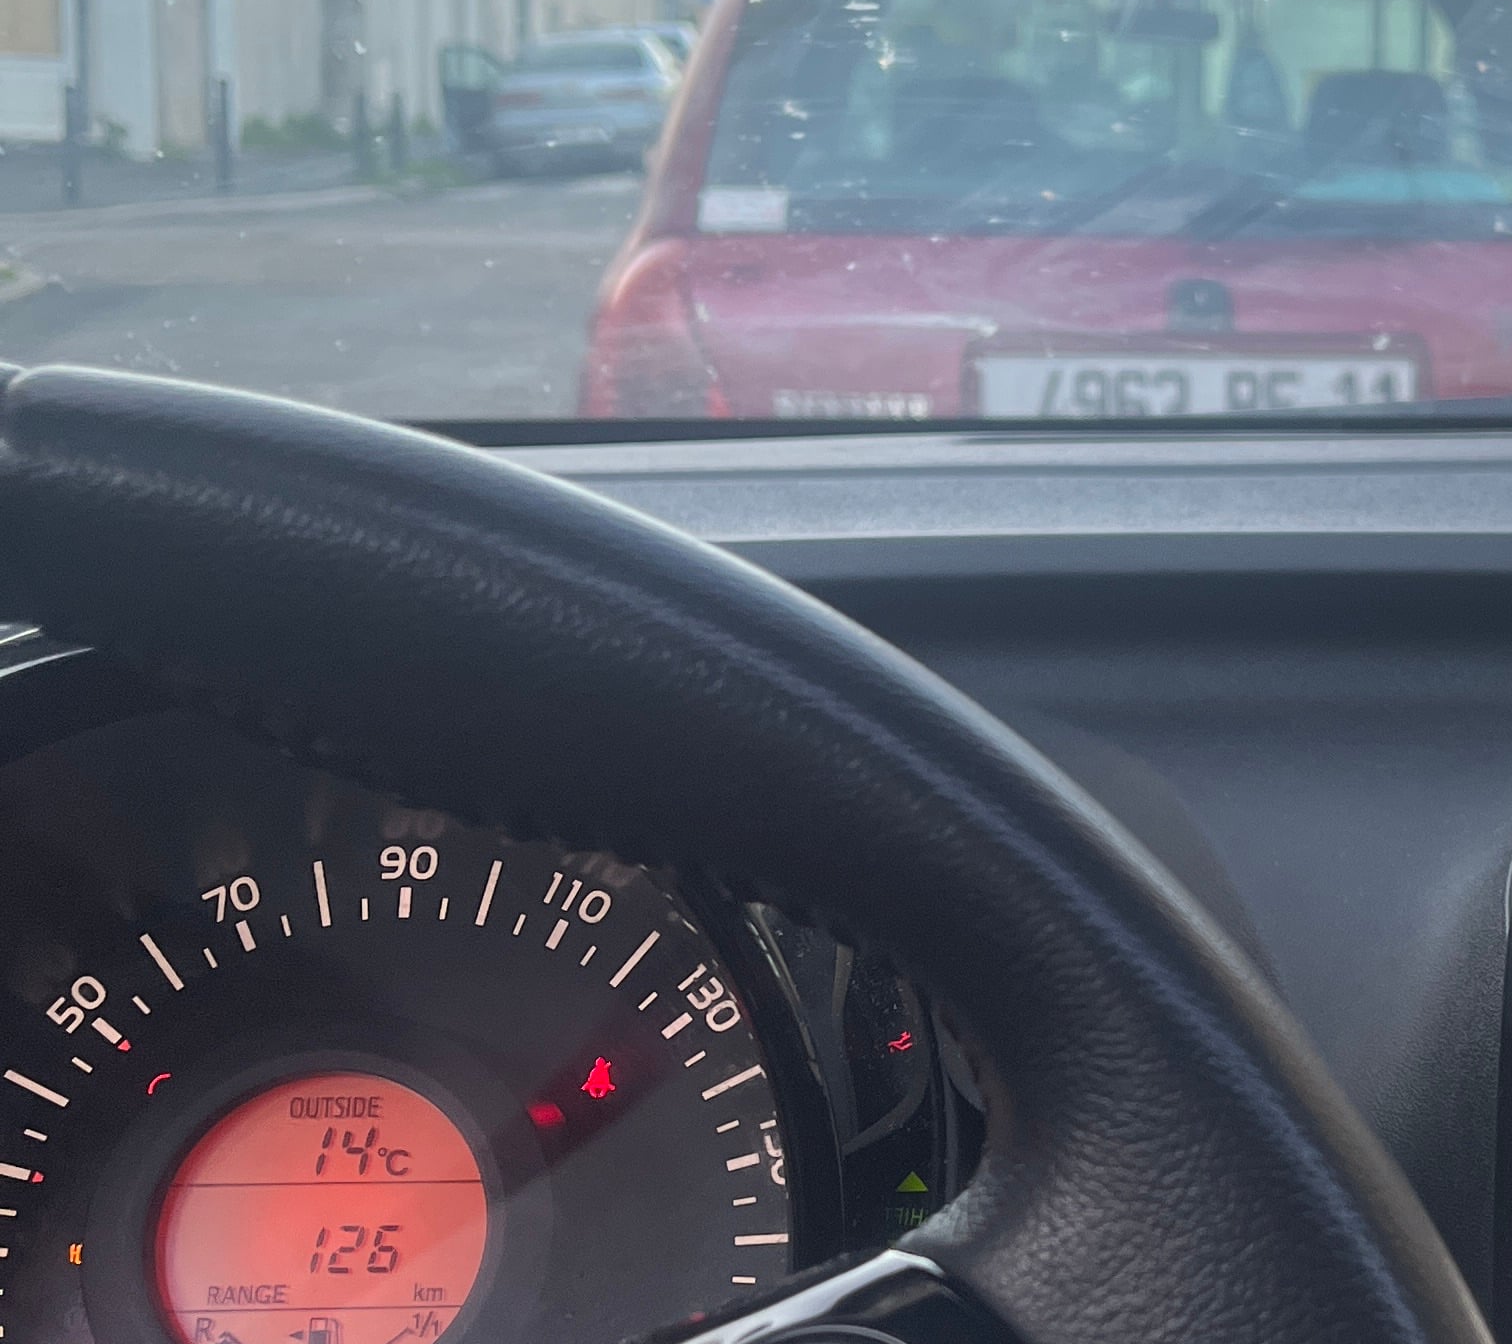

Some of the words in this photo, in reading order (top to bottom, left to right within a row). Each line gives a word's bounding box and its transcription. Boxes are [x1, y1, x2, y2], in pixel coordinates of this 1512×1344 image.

[380, 845, 439, 881] 90
[200, 875, 261, 924] 70
[544, 872, 611, 925] 110
[46, 975, 107, 1035] 50
[677, 964, 742, 1032] 130
[290, 1096, 381, 1119] OUTSIDE
[310, 1224, 402, 1274] 126
[207, 1284, 288, 1305] RANGE
[414, 1282, 444, 1302] km
[195, 1317, 213, 1342] R
